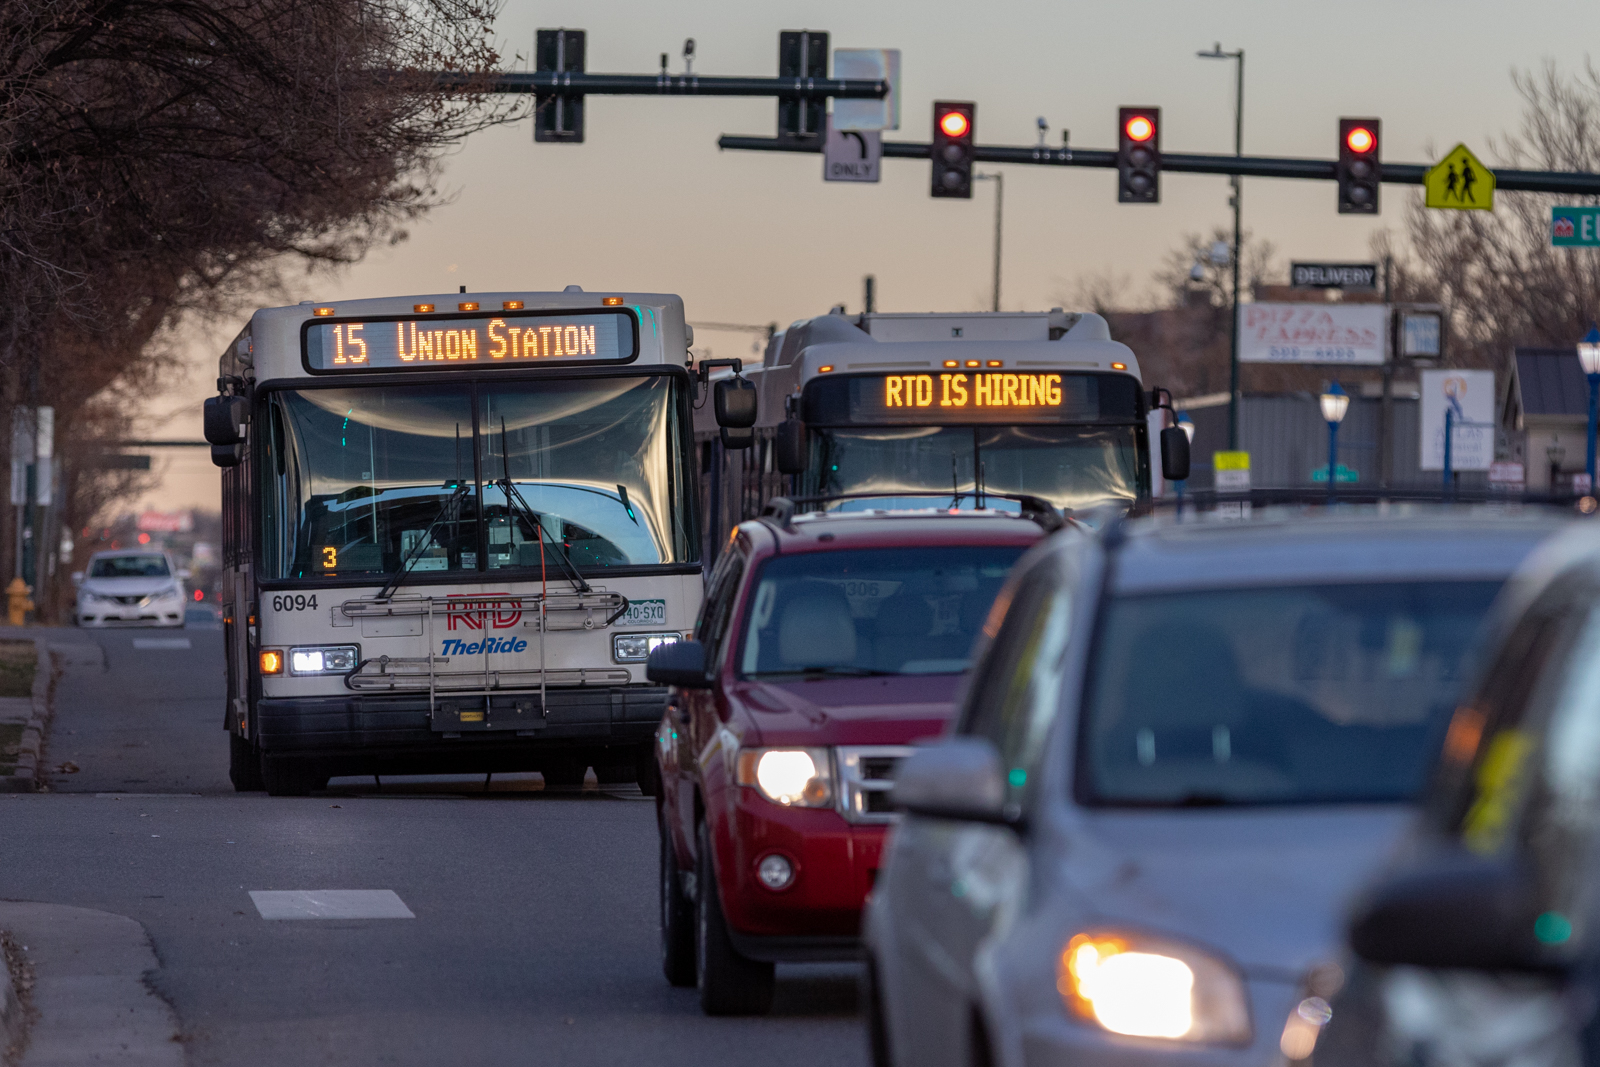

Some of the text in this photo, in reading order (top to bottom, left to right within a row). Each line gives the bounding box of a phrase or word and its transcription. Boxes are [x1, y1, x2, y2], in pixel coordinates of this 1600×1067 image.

[832, 163, 872, 176] ONLY
[1296, 267, 1374, 284] DELIVERY
[333, 324, 367, 363] 15
[886, 374, 1062, 406] RTD IS HIRING
[323, 547, 337, 568] 3
[272, 594, 319, 612] 6094
[446, 592, 523, 631] RTD
